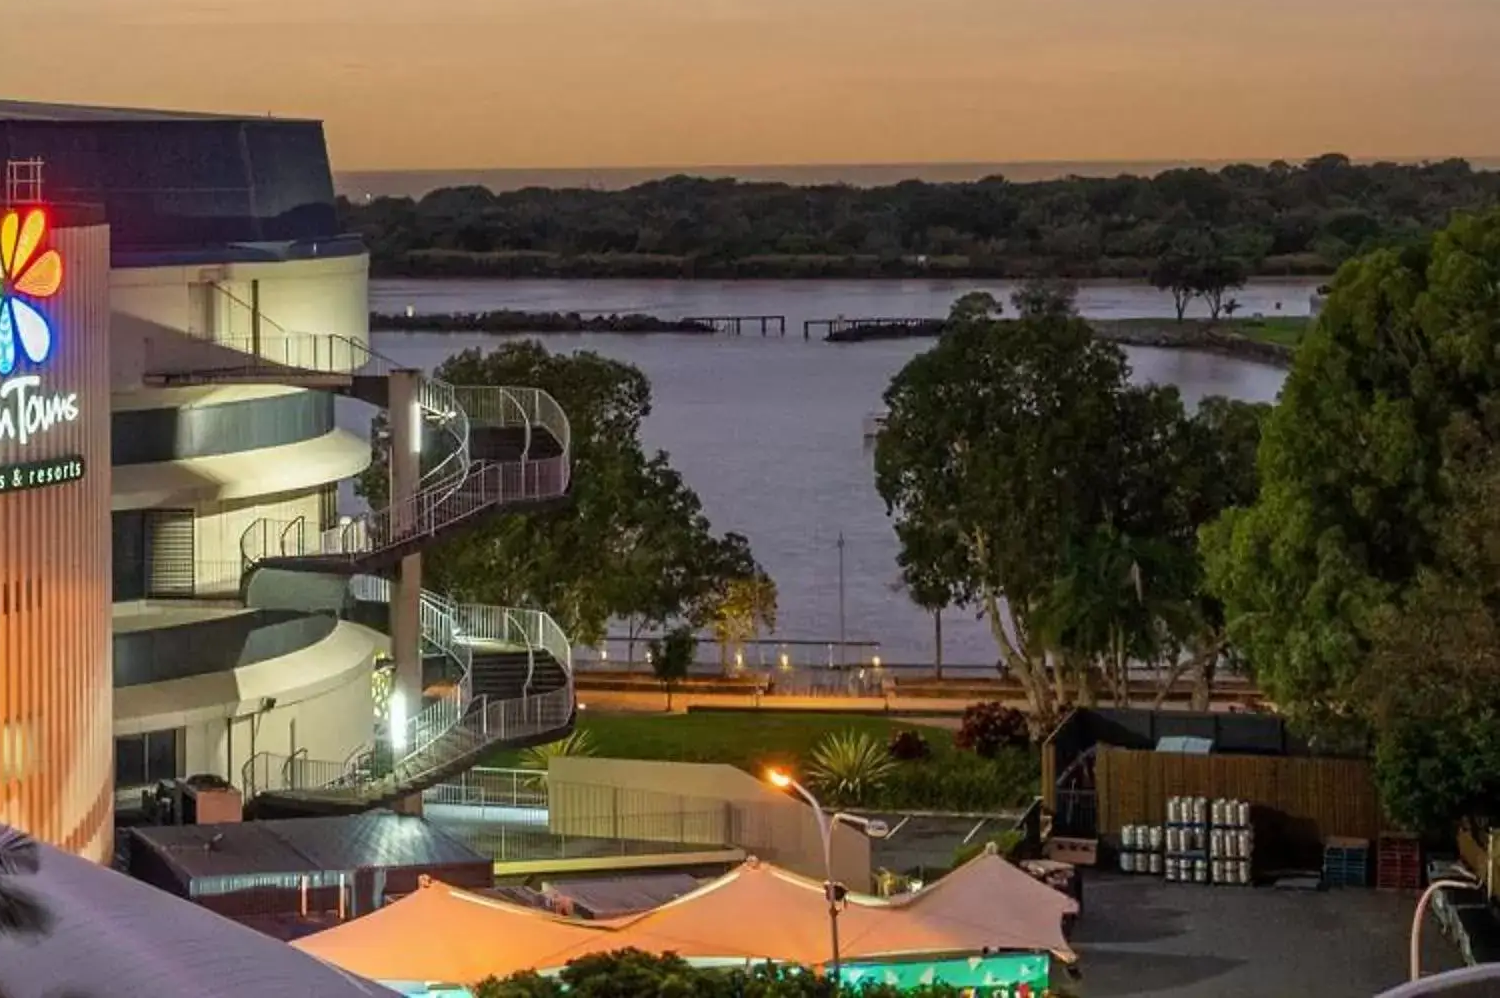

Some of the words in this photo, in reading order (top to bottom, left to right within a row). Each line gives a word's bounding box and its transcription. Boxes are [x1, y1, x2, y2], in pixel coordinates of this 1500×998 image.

[0, 375, 79, 444] Towns
[12, 468, 23, 487] &
[29, 461, 82, 484] resorts
